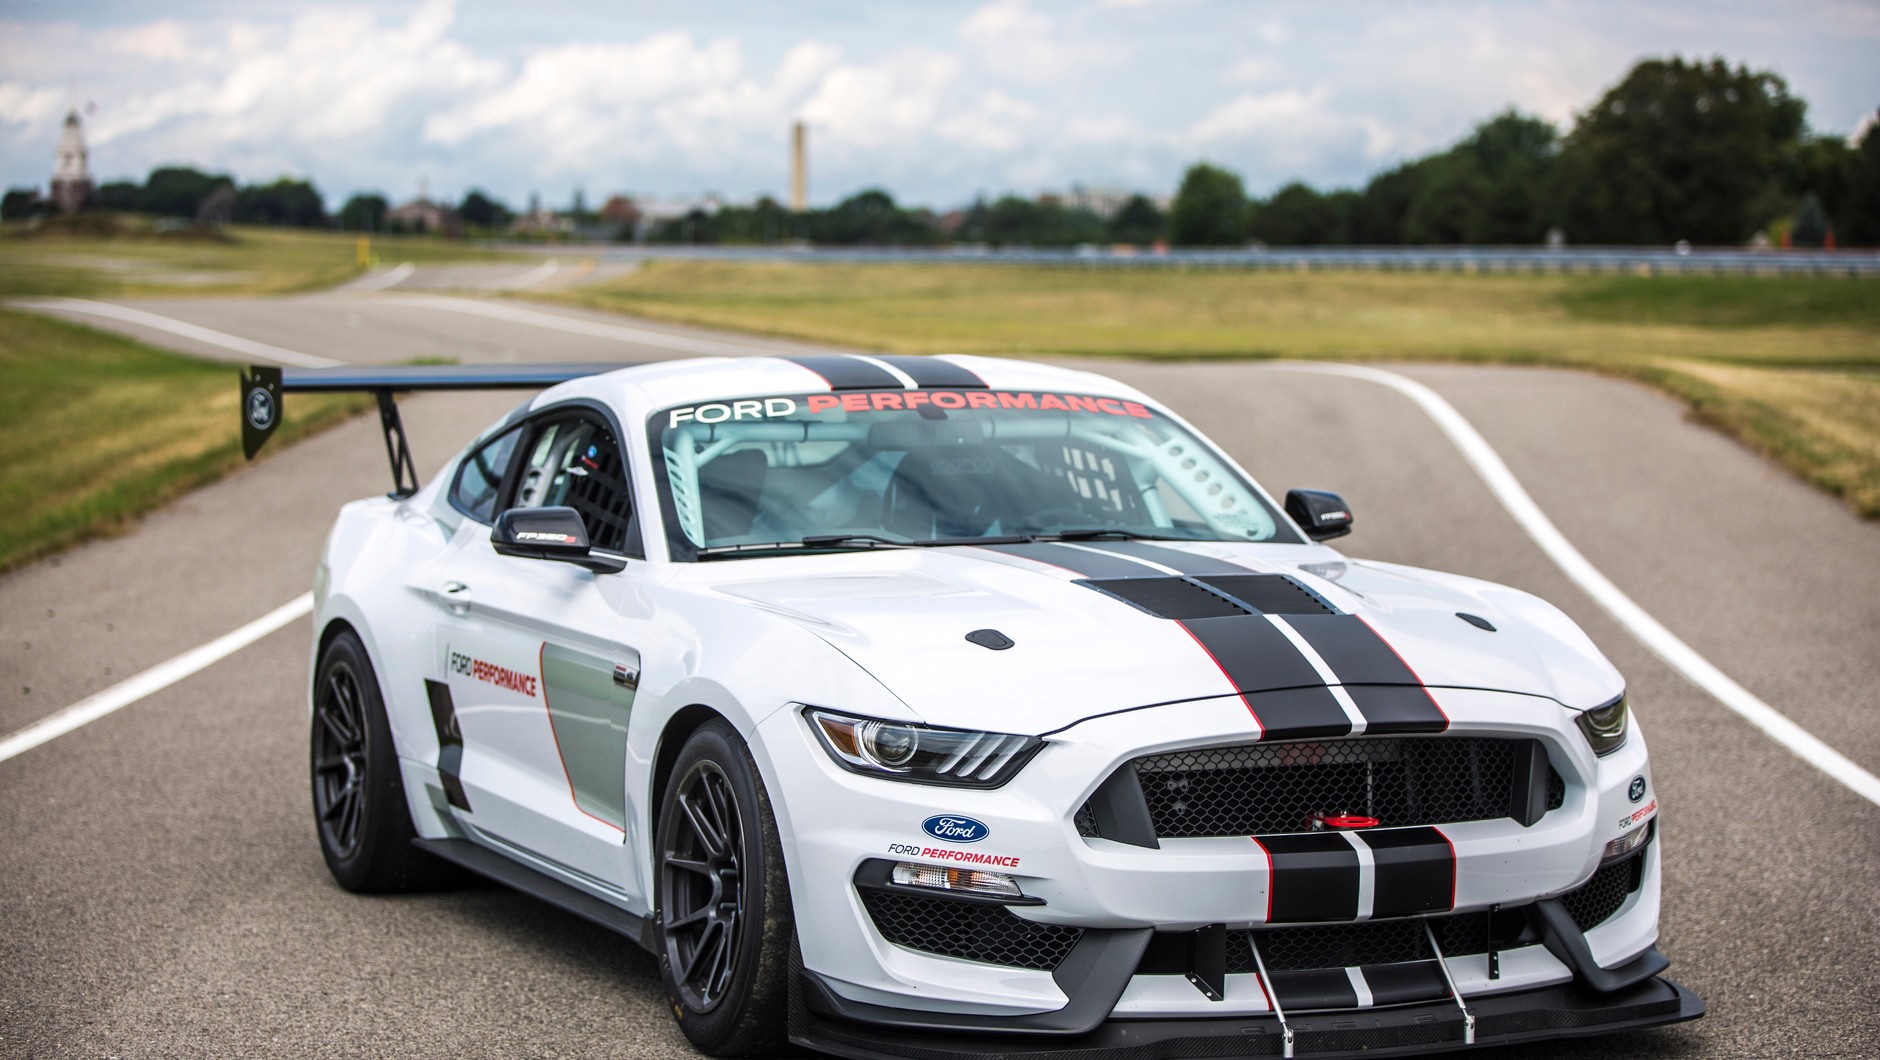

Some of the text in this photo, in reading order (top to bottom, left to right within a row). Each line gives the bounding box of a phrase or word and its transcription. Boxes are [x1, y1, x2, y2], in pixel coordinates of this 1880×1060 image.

[669, 391, 1154, 429] FORD PERFORMANCE
[451, 652, 537, 698] FORD PERFORMANCE
[934, 817, 976, 839] Ford
[887, 843, 1020, 868] FORD PERFORMANCE
